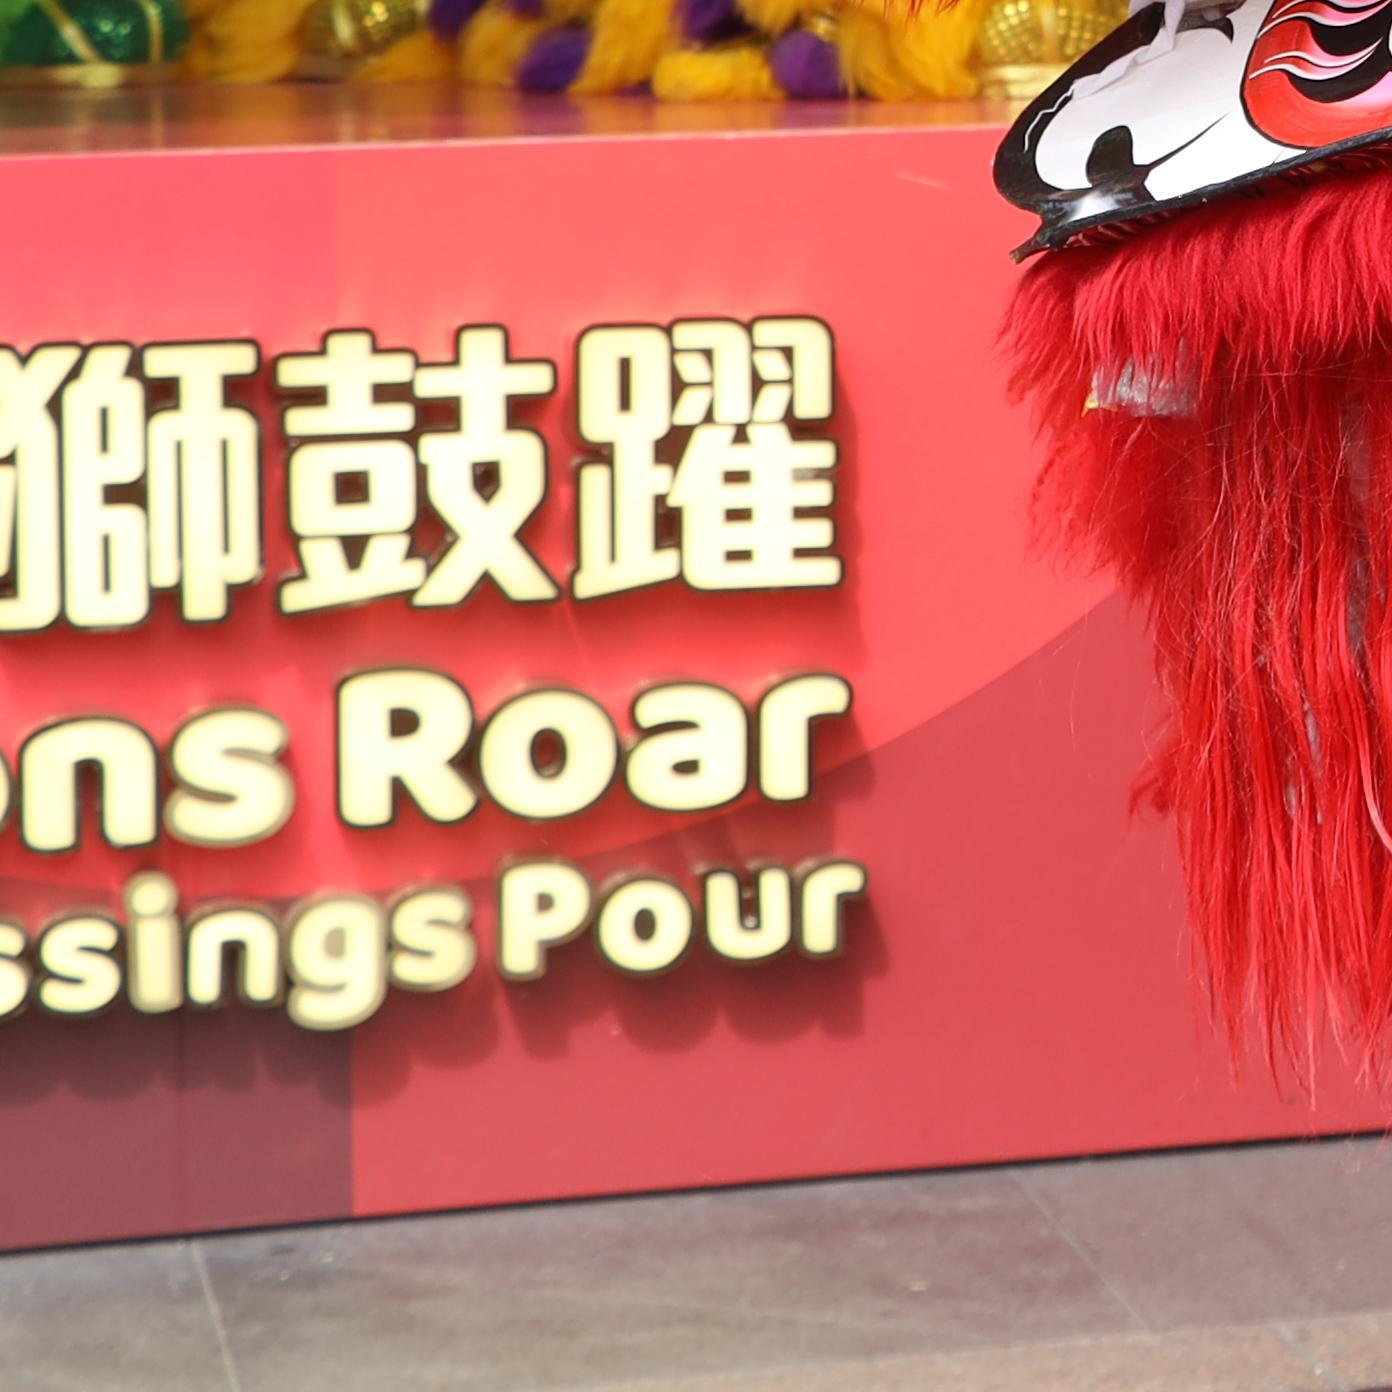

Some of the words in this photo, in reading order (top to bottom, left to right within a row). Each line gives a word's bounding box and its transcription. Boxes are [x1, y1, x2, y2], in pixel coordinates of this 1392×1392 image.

[0, 317, 842, 631] 獅鼓躍
[0, 706, 294, 851] ns
[337, 667, 852, 828] Roar
[498, 859, 867, 979] Pour
